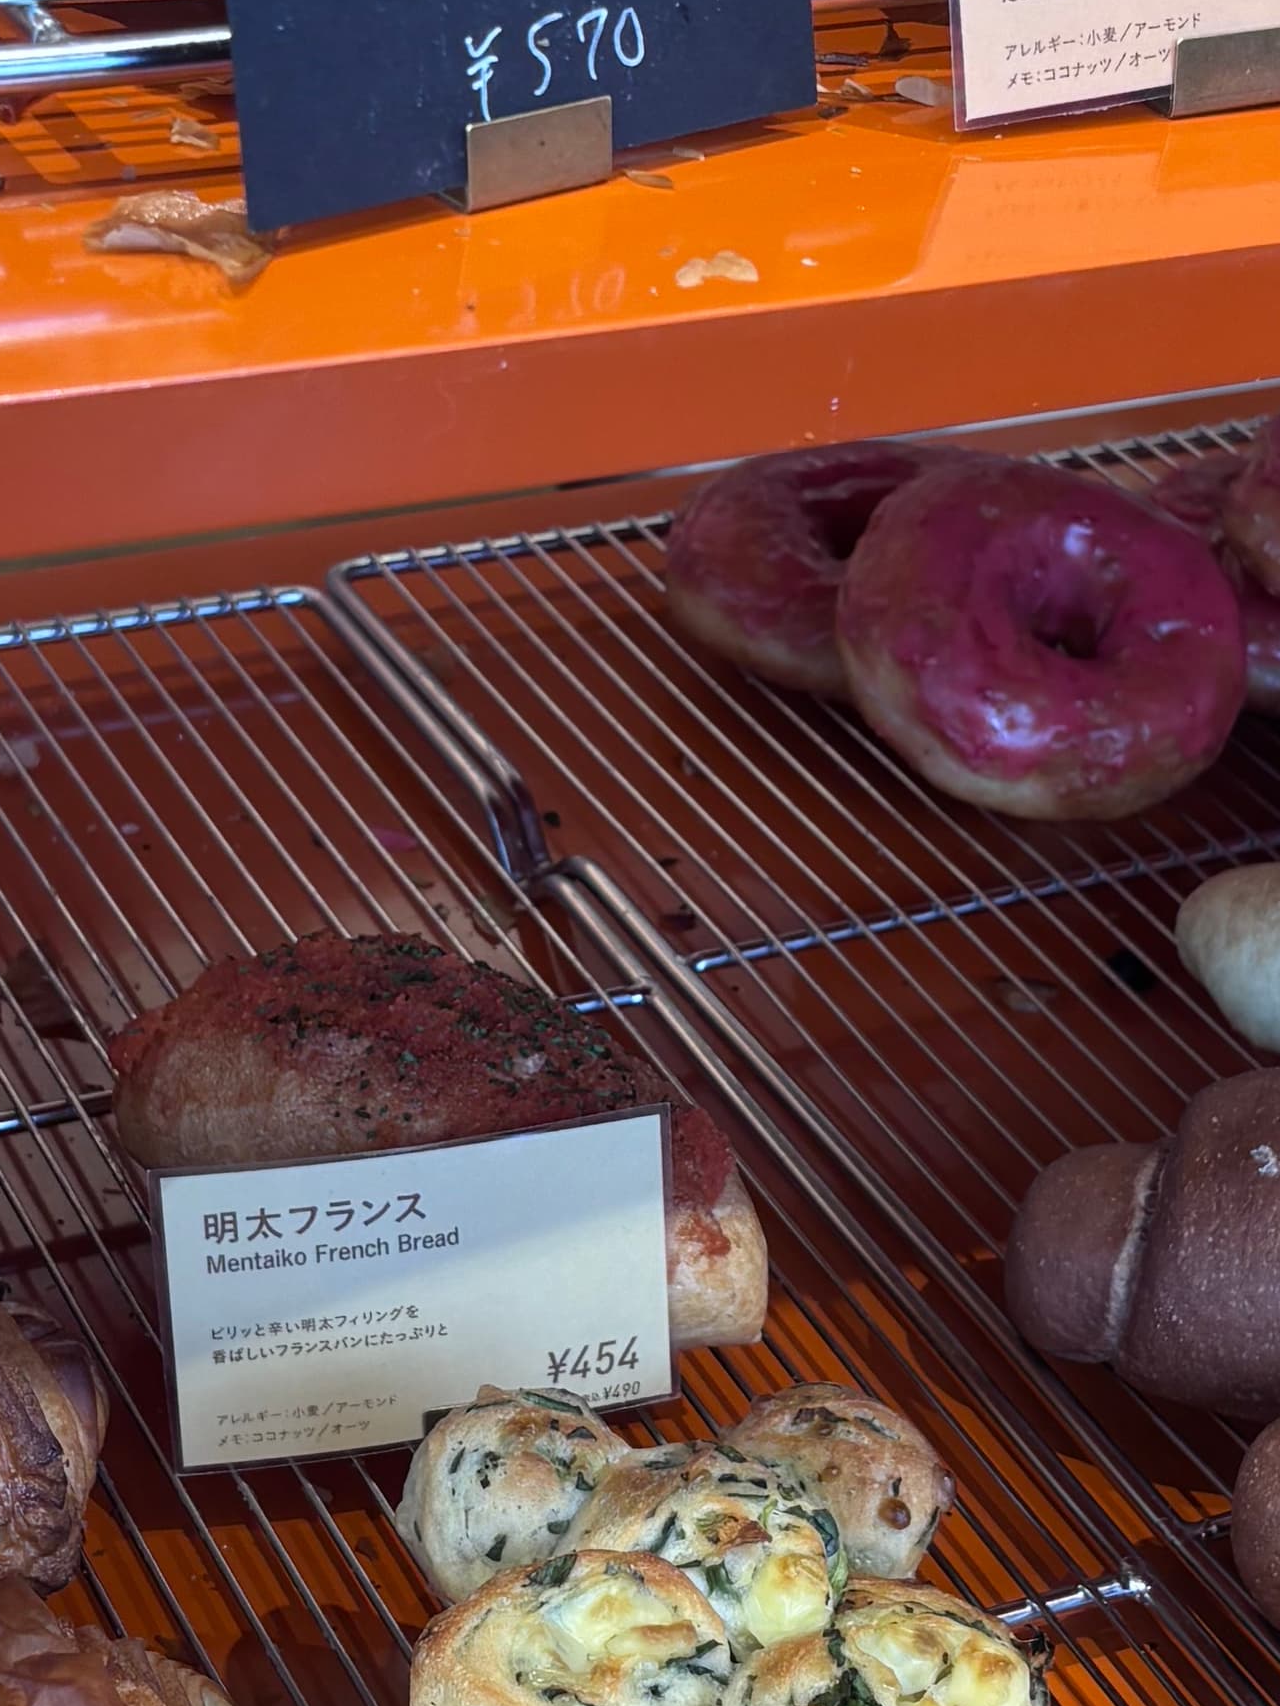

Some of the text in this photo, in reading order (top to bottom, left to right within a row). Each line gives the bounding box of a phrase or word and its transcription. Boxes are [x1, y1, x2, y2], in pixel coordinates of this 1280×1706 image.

[465, 7, 646, 123] ¥570
[203, 1191, 427, 1244] 明太フランス
[206, 1226, 460, 1275] Mentaiko French Bread
[212, 1323, 449, 1365] 香ばしいフランスパンにたっぷりと
[546, 1335, 639, 1384] ¥454
